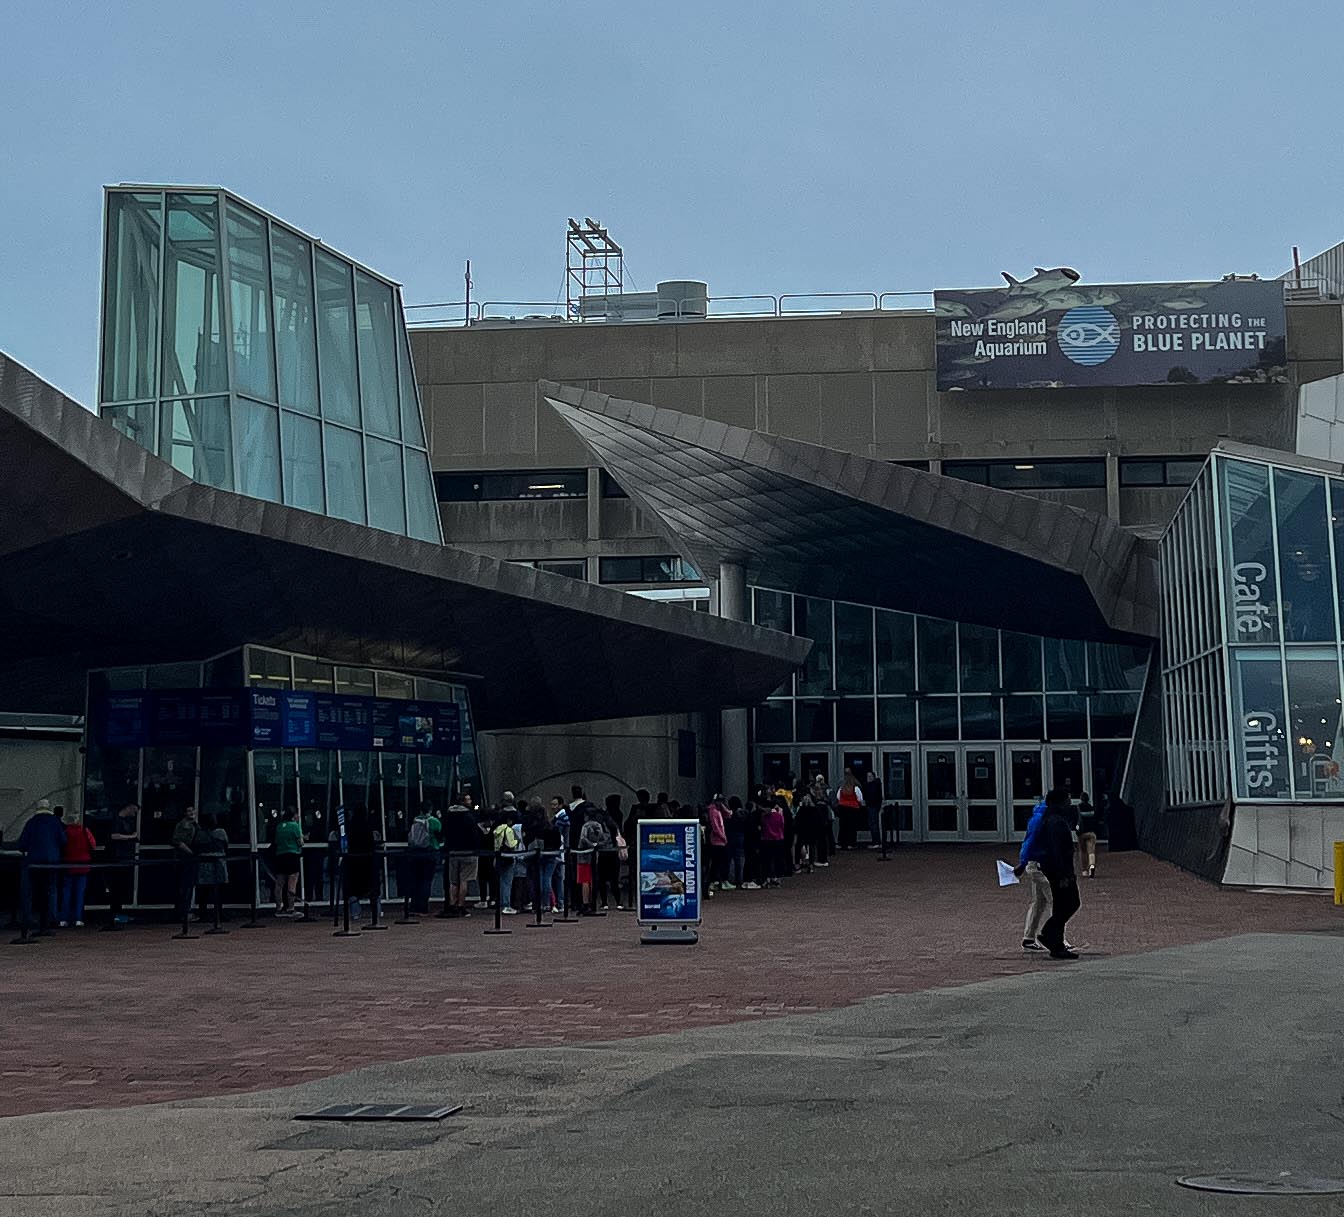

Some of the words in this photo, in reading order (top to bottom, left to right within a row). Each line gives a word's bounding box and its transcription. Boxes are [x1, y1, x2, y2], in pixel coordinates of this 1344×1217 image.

[951, 320, 987, 338] New
[987, 318, 1047, 339] England
[1132, 313, 1242, 331] PROTECTING
[1247, 317, 1267, 328] THE
[974, 339, 1048, 360] Aquarium
[1133, 332, 1184, 353] BLUE
[1191, 331, 1267, 352] PLANET
[1232, 561, 1272, 634] Café
[1242, 711, 1279, 789] Gifts
[684, 826, 696, 868] PLAYING
[685, 870, 696, 894] NOW
